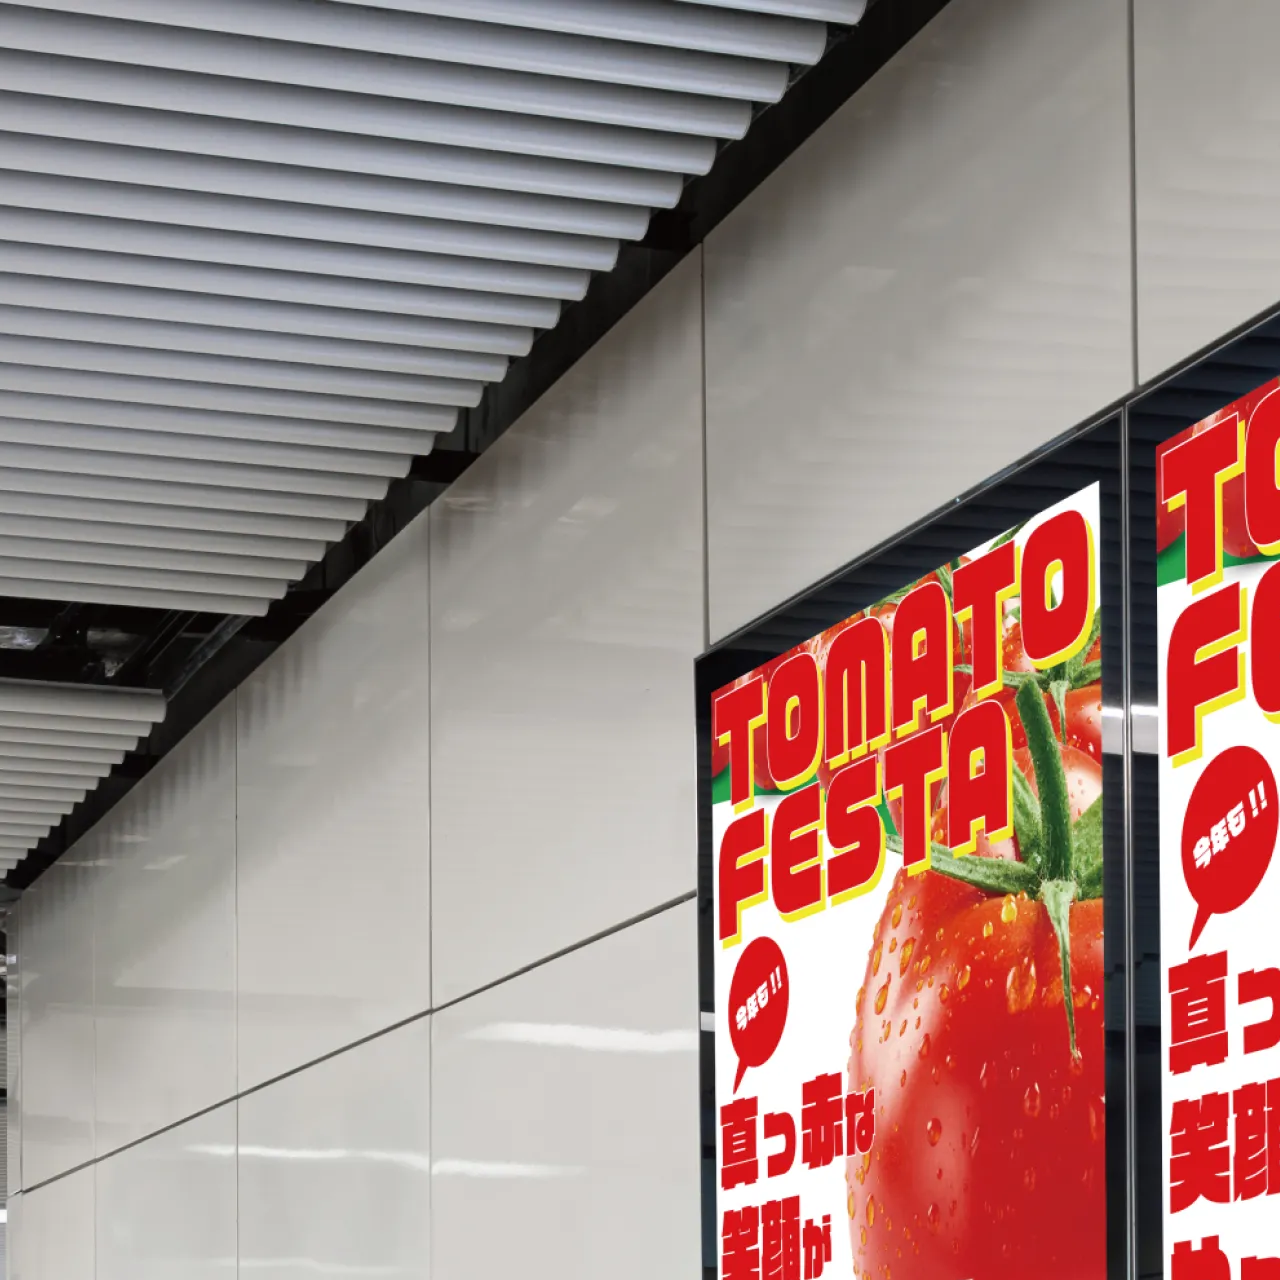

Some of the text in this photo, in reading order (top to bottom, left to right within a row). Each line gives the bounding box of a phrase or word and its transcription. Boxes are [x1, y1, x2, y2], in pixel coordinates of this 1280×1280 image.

[714, 509, 1095, 814] TOMATO
[718, 697, 1014, 950] FESTA
[720, 1071, 876, 1190] 真っ赤な
